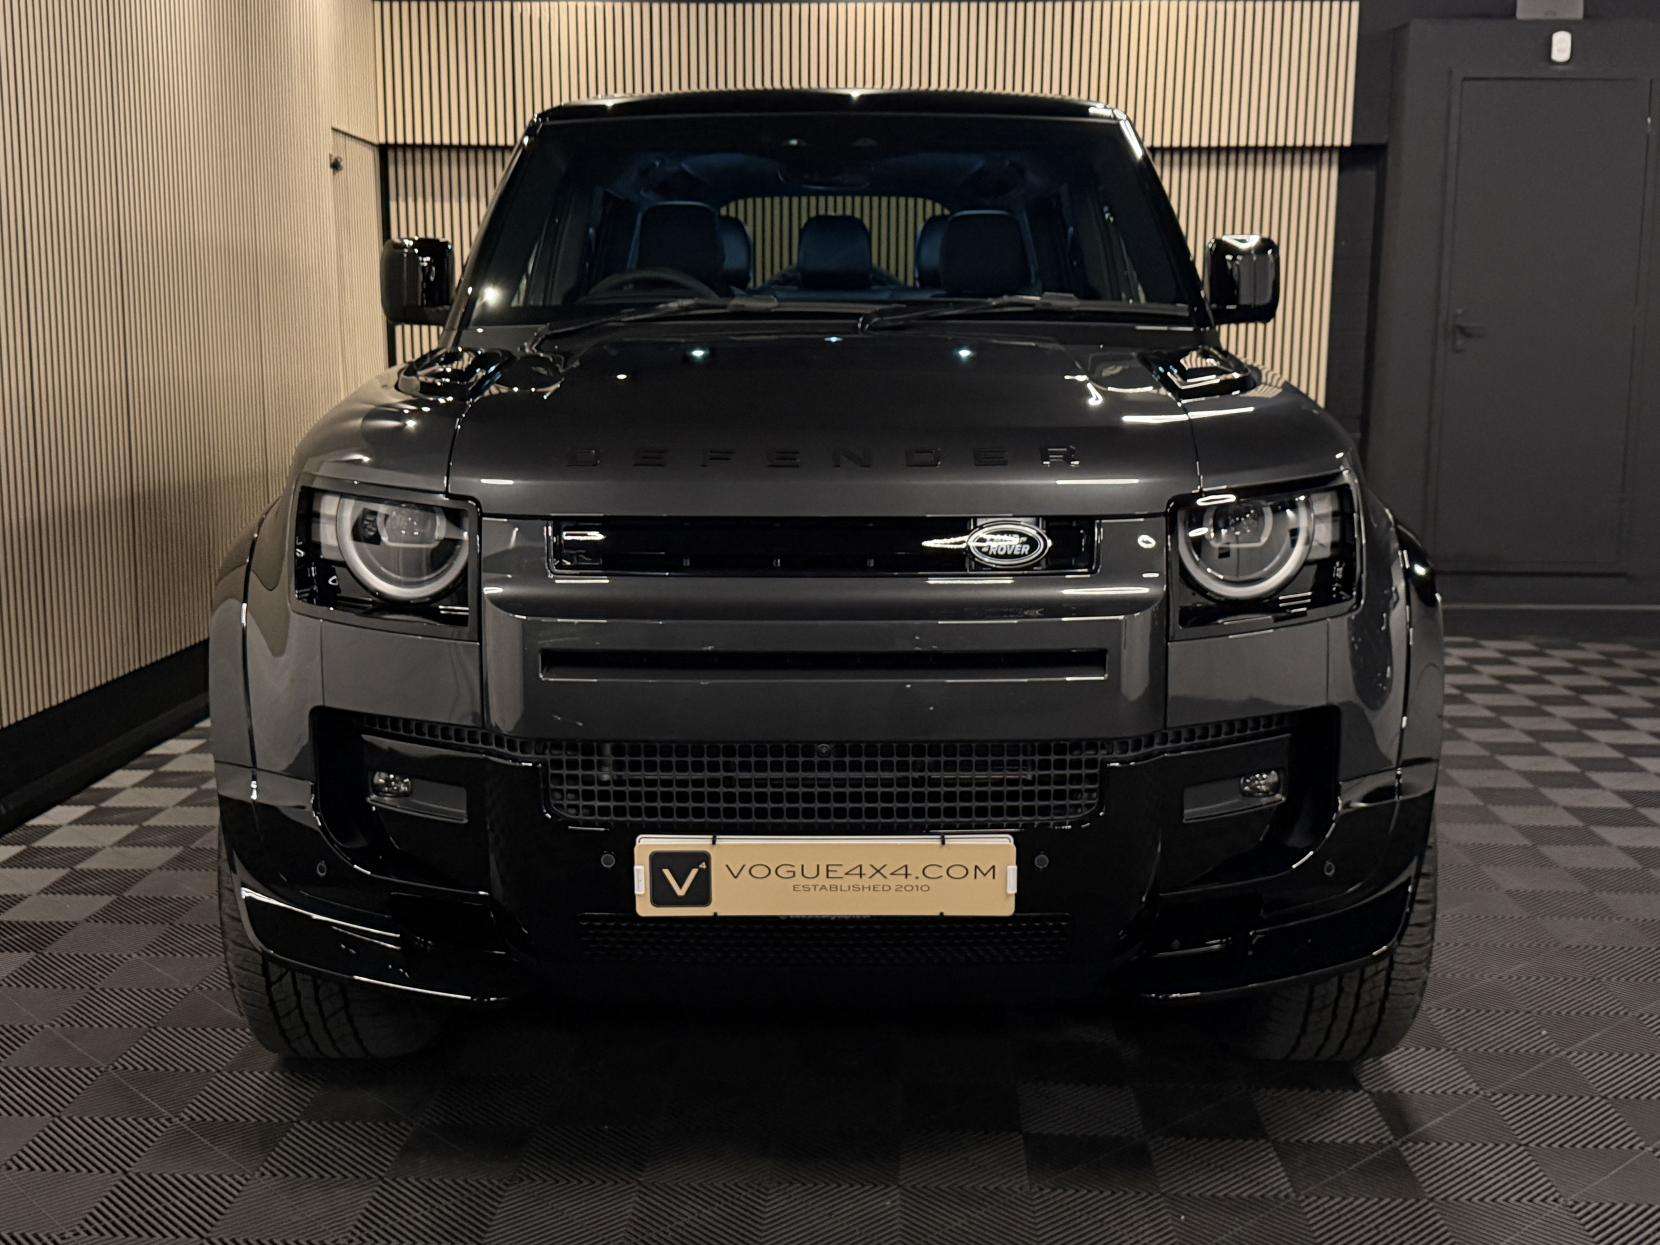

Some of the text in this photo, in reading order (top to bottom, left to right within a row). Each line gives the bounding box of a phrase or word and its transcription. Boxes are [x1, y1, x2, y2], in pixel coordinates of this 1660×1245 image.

[565, 445, 1080, 467] DEFENDER
[988, 544, 1030, 555] ROVER
[725, 863, 997, 880] VOGUE4X4.COM
[792, 883, 931, 893] ESTABLISHED 2010
